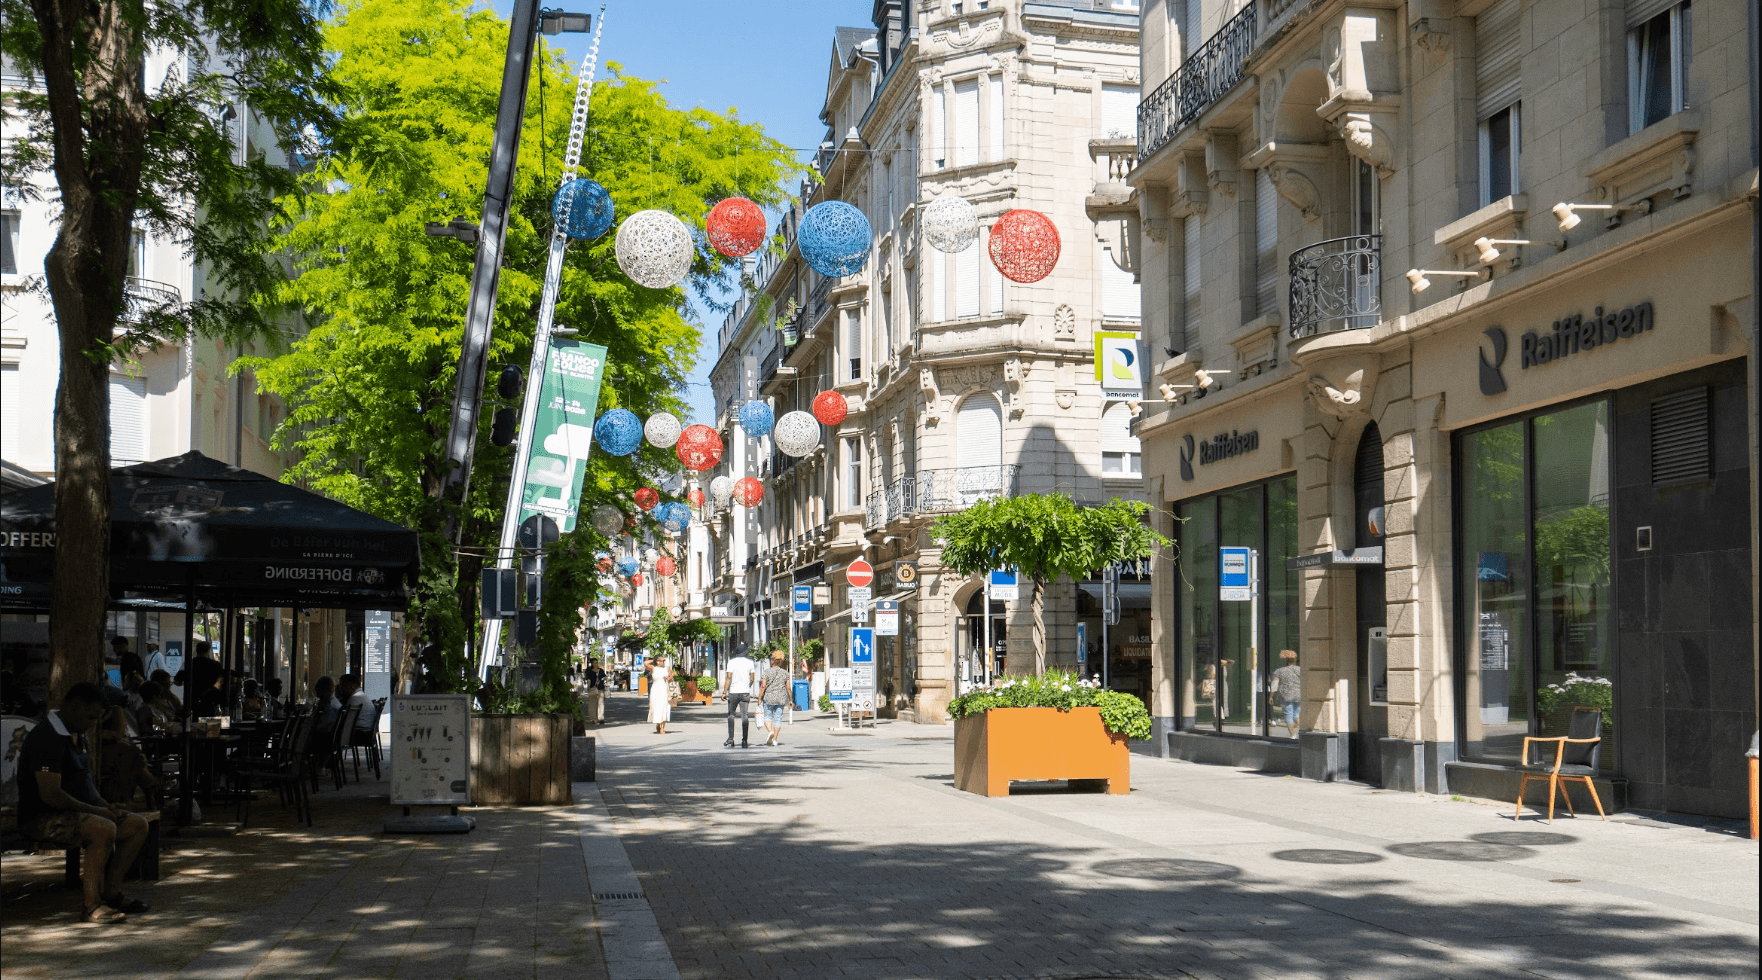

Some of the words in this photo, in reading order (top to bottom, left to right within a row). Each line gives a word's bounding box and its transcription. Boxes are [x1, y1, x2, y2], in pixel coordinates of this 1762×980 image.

[1521, 301, 1654, 369] Raiffeisen
[1199, 430, 1259, 465] Raiffeisen
[1, 532, 56, 547] OFFER
